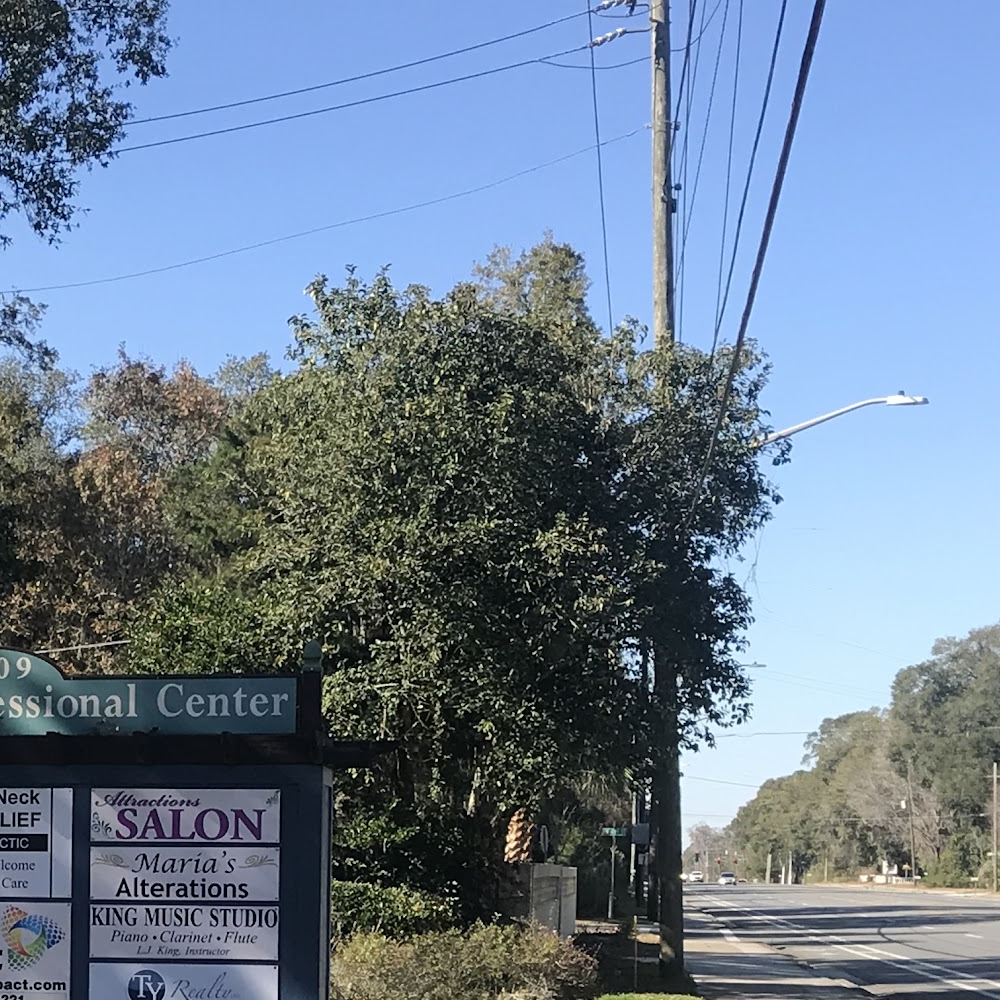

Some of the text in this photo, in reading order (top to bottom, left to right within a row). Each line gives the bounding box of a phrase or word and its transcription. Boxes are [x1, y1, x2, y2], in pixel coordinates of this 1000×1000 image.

[157, 684, 289, 718] Center
[95, 790, 201, 807] Attractions
[115, 808, 266, 840] SALON
[2, 878, 28, 889] Care
[115, 877, 249, 898] Alterations
[92, 907, 278, 928] KING MUSIC STUDIO
[111, 930, 258, 944] Piano Clarinet Flute
[185, 946, 230, 956] Instructor
